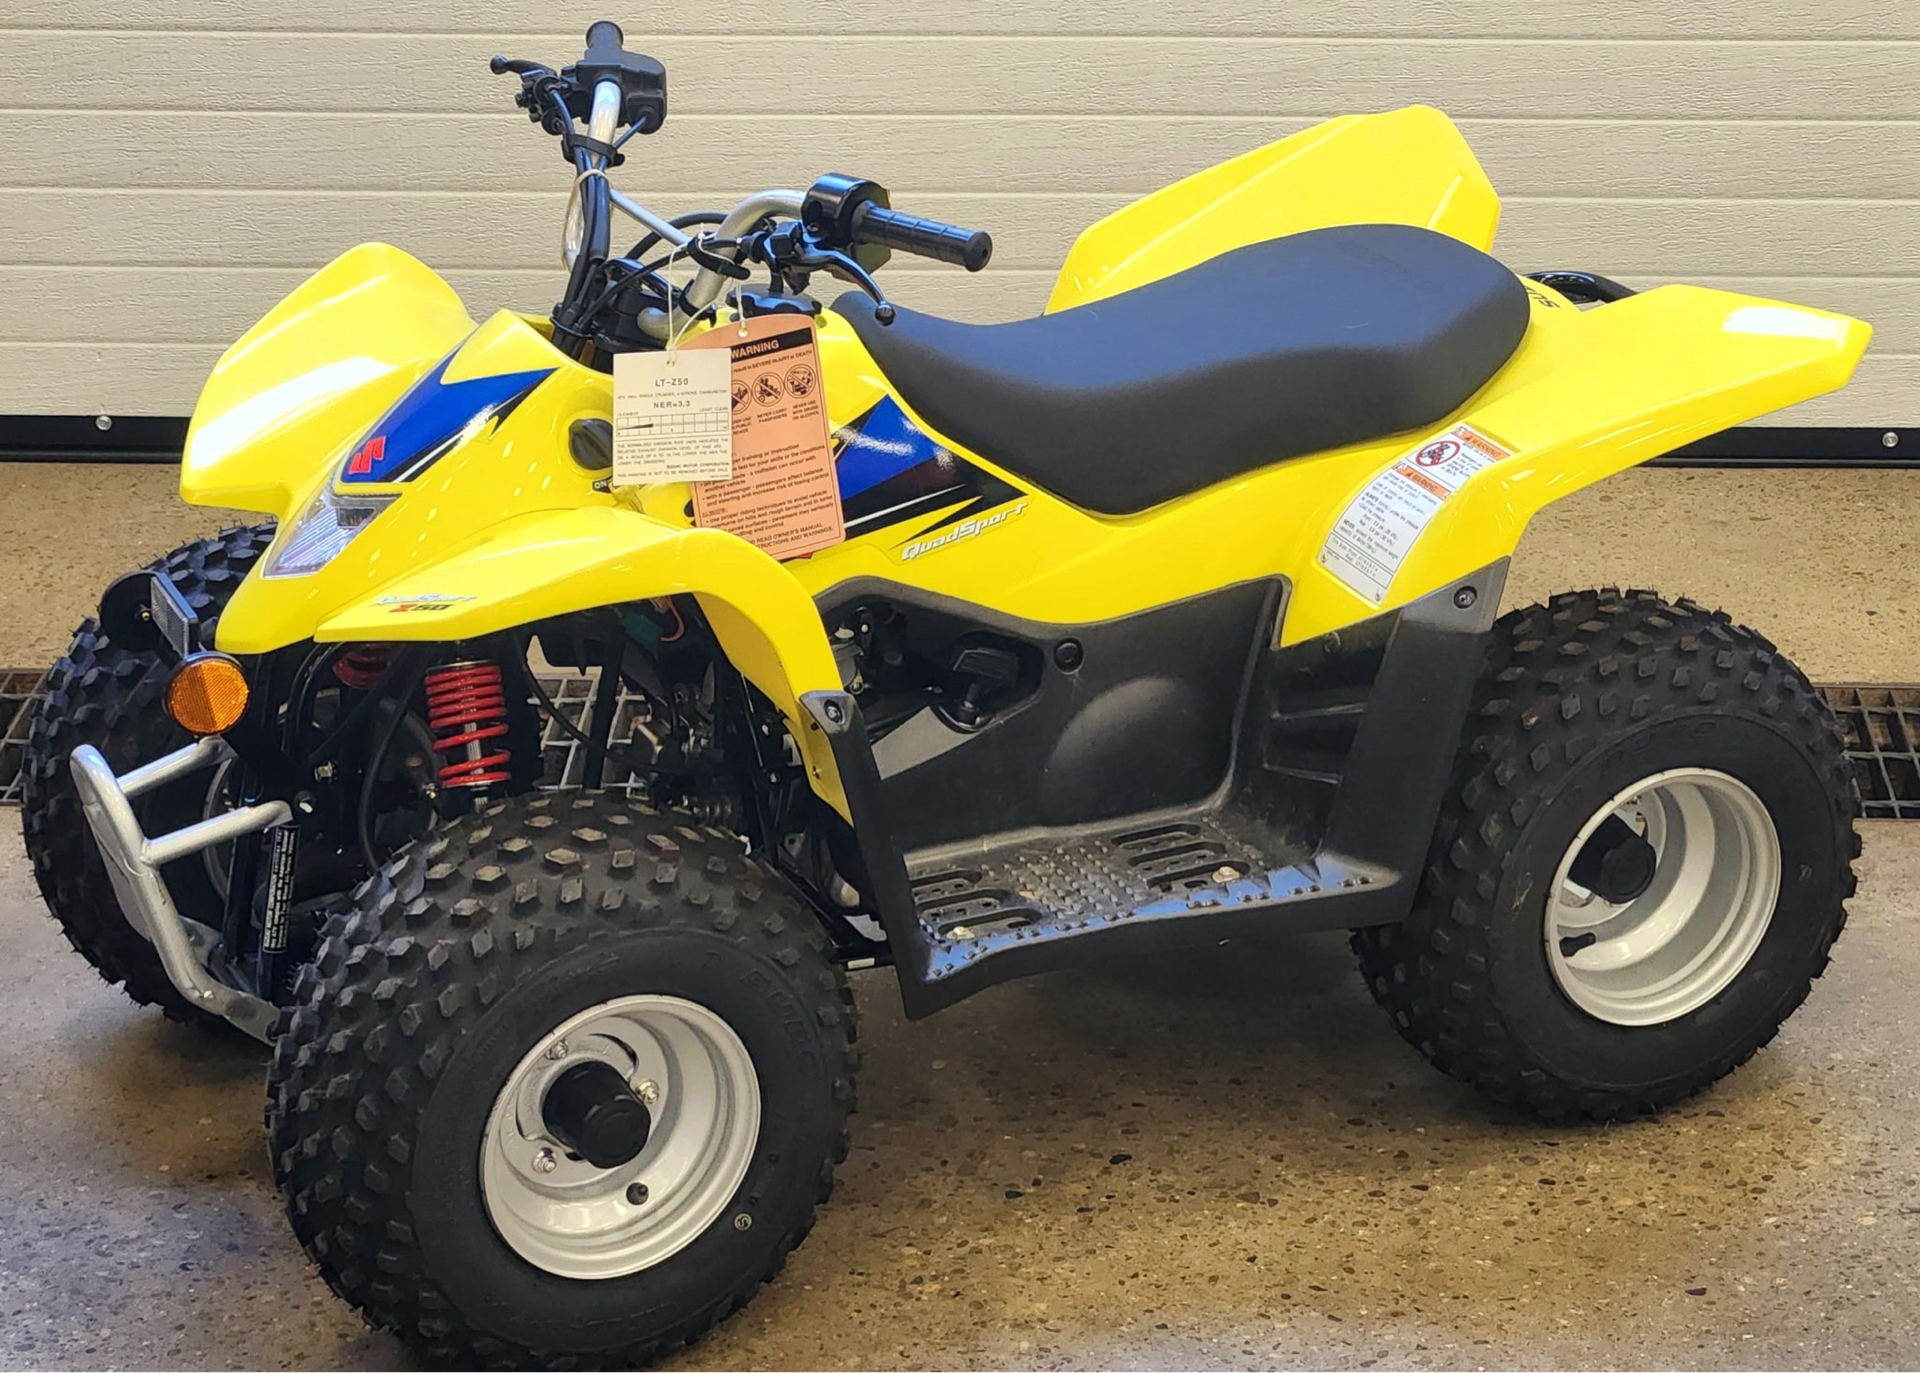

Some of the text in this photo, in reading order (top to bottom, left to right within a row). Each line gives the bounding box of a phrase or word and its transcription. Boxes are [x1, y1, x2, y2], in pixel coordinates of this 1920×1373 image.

[730, 339, 779, 358] WARNING
[752, 359, 771, 369] SEVERE
[772, 355, 789, 363] INJURY
[795, 350, 812, 358] DEATH
[655, 377, 689, 387] LT-Z50
[653, 400, 690, 408] NER=3.3
[758, 413, 787, 423] PASSENGERS
[799, 410, 819, 419] ALCOHOL
[741, 452, 763, 462] training
[770, 444, 799, 454] instruction
[756, 459, 769, 467] your
[799, 444, 825, 455] conditions
[1471, 438, 1501, 457] WARNING
[754, 465, 777, 475] collision
[788, 458, 804, 466] occur
[704, 484, 726, 493] another
[726, 479, 746, 487] vehicle
[718, 495, 740, 504] steering
[752, 487, 775, 496] increase
[810, 471, 829, 481] control
[722, 486, 751, 497] passenger
[755, 477, 786, 490] passengers
[787, 472, 802, 481] affect
[802, 467, 823, 476] balance
[1412, 474, 1438, 492] WARNING
[720, 512, 739, 521] proper
[756, 501, 786, 512] techniques
[793, 494, 808, 503] avoid
[808, 490, 828, 498] vehicle
[768, 507, 784, 515] rough
[784, 503, 802, 511] terrain
[744, 519, 768, 528] surfaces
[771, 511, 798, 523] pavement
[810, 502, 834, 512] seriously
[764, 521, 784, 530] control
[901, 502, 1028, 561] QuadSport
[756, 535, 772, 543] READ
[772, 528, 799, 539] OWNER'S
